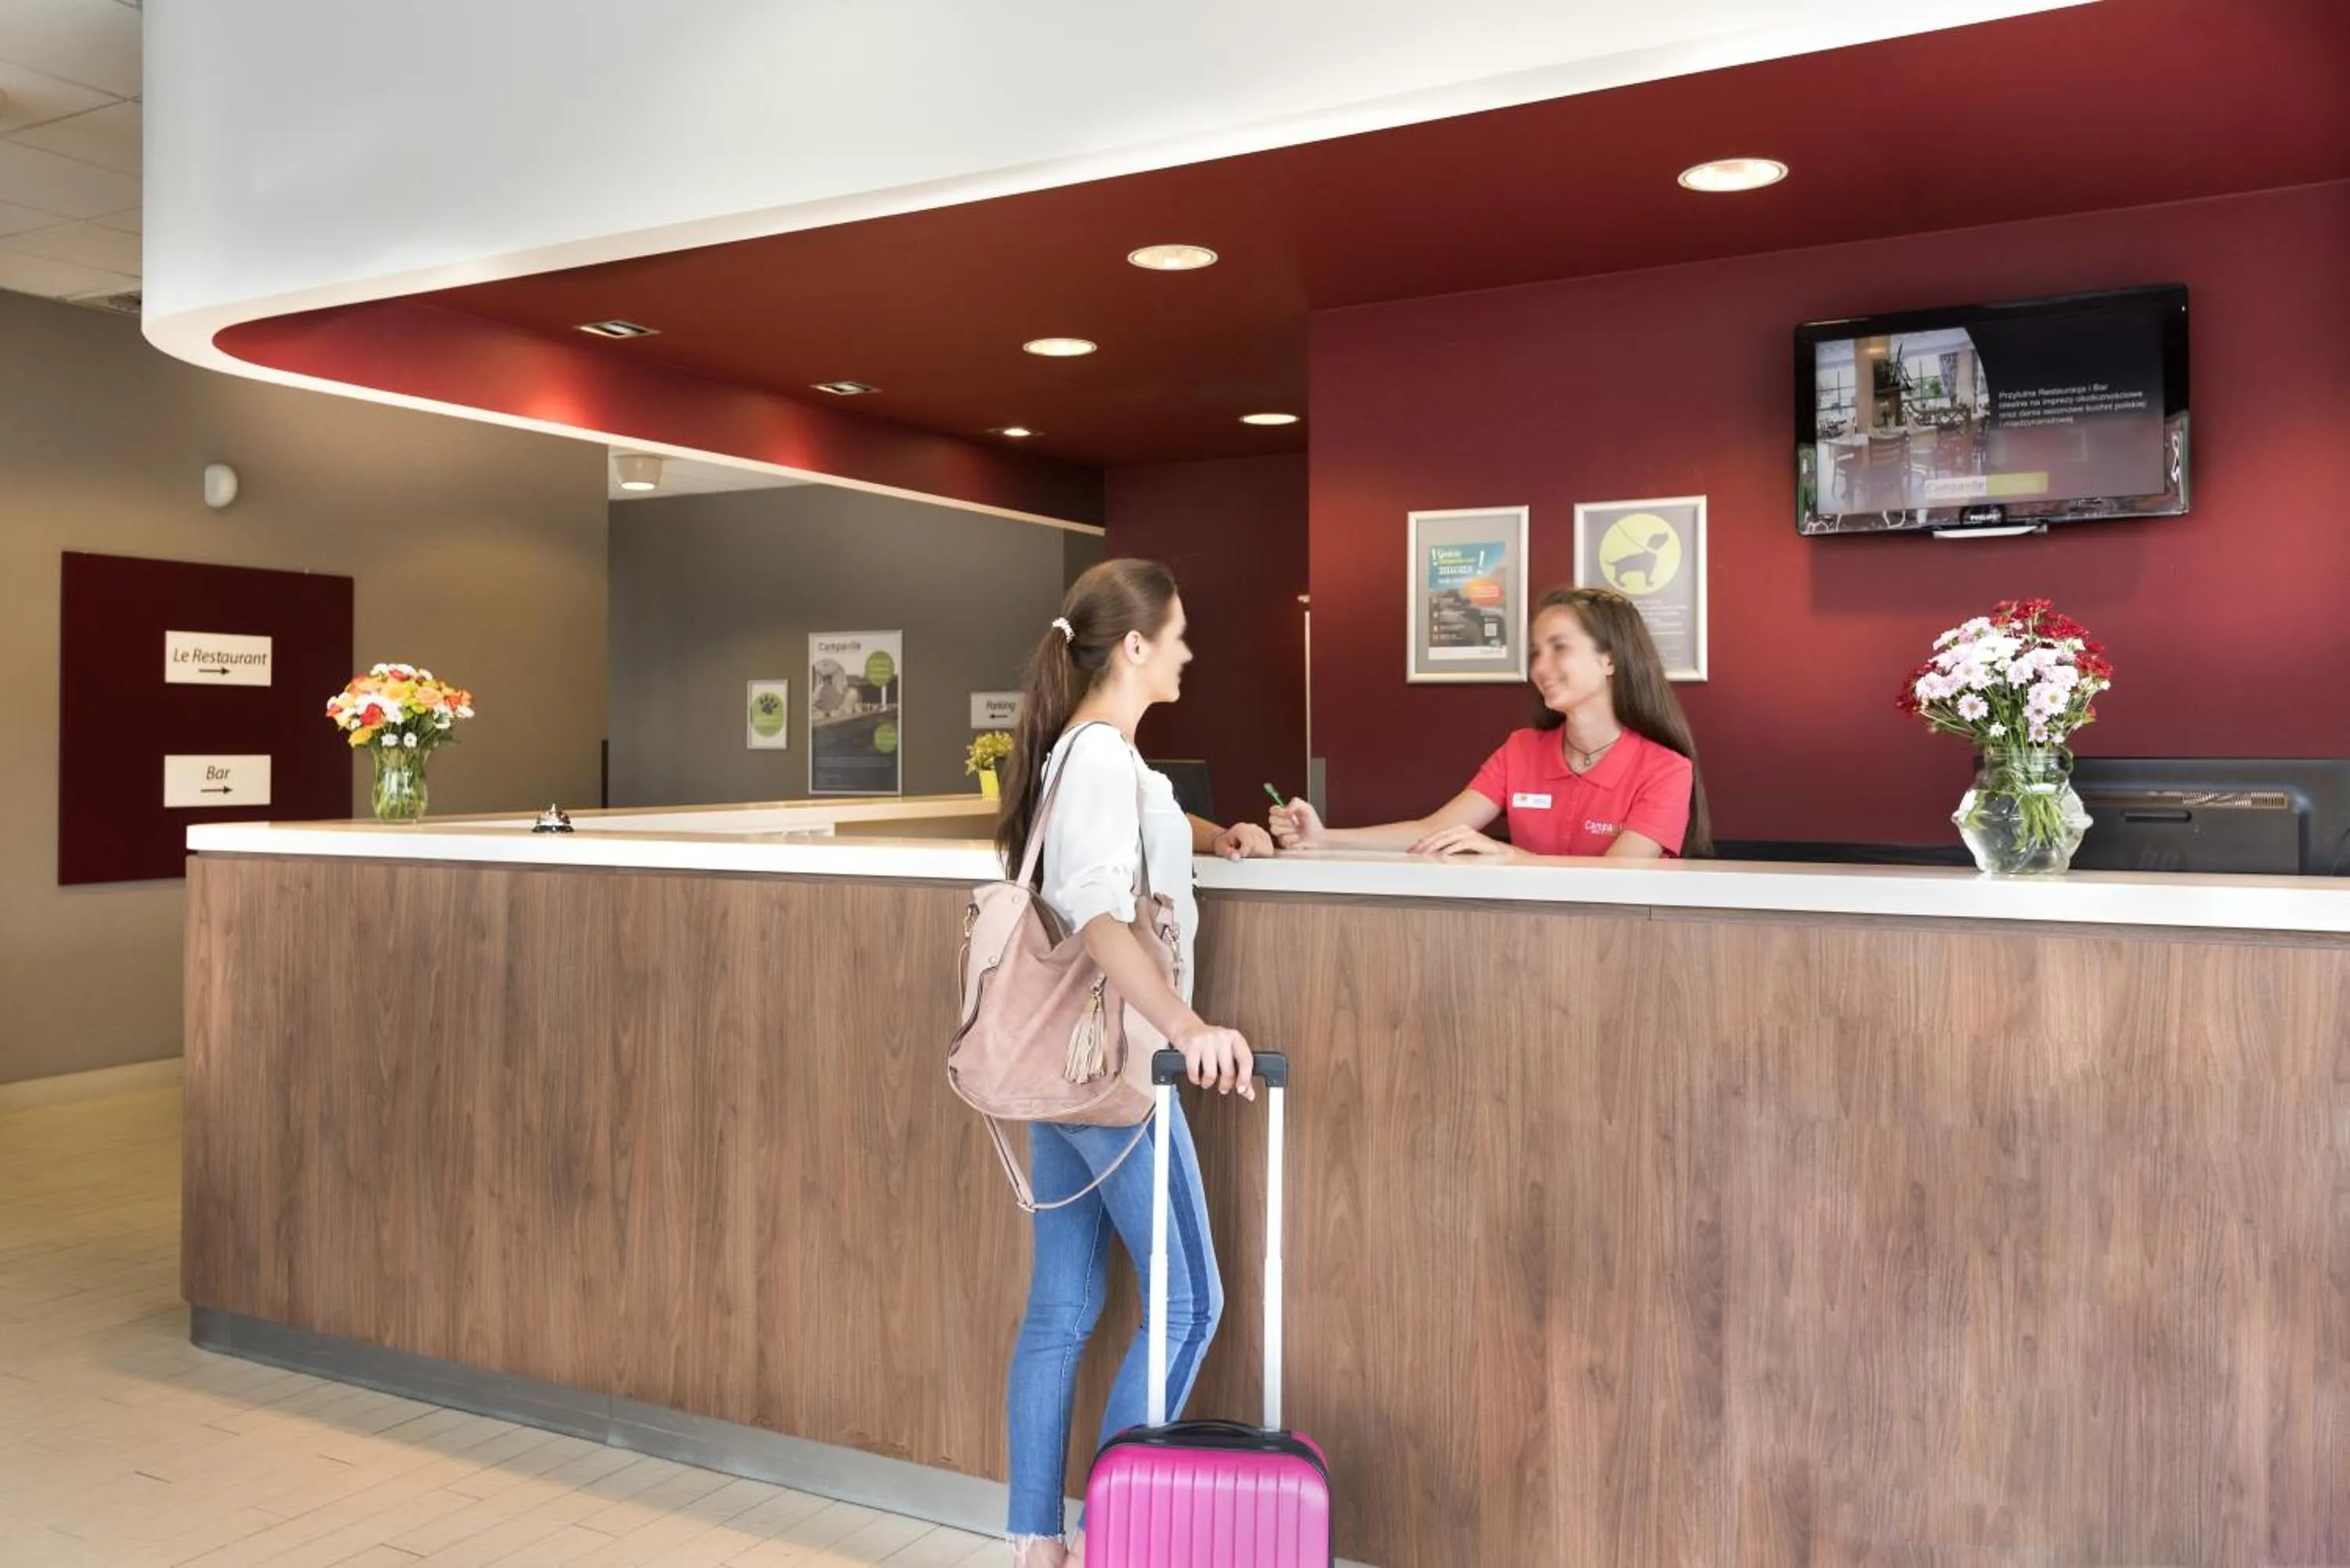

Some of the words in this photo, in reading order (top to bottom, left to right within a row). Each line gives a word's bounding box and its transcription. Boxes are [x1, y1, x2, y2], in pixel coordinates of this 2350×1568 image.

[173, 649, 189, 662] Le
[192, 649, 267, 665] Restaurant
[206, 765, 230, 780] Bar
